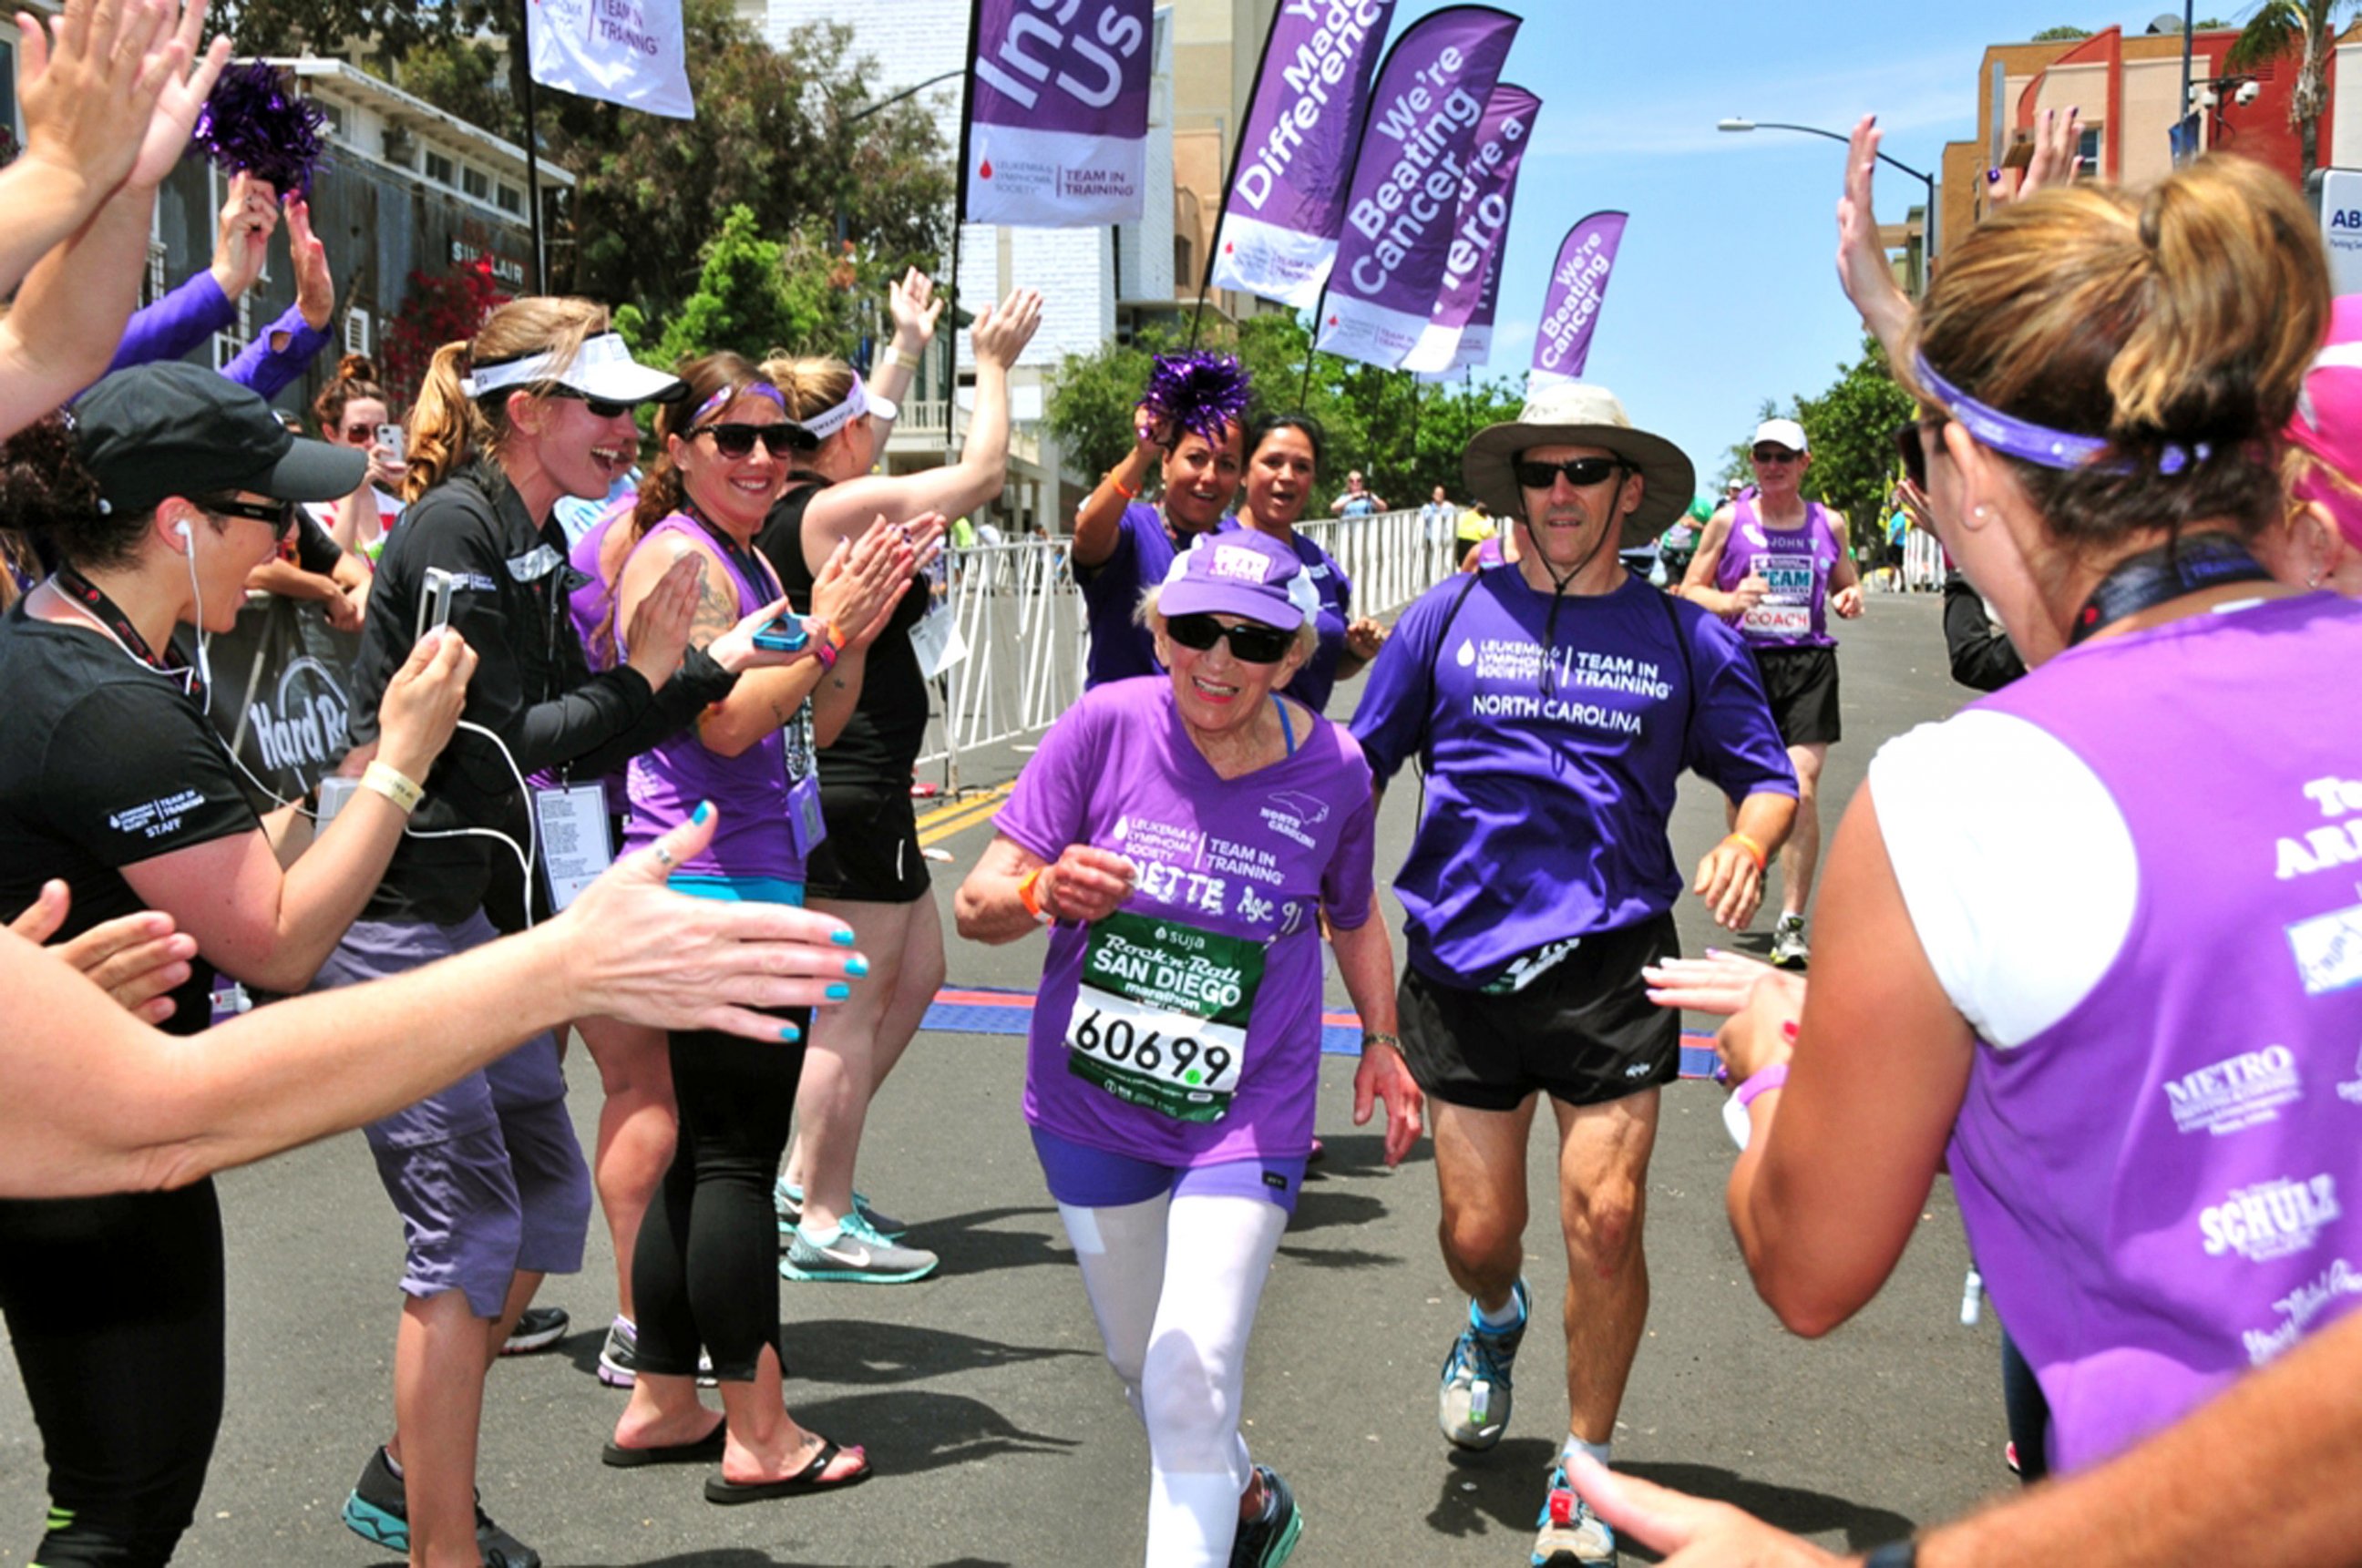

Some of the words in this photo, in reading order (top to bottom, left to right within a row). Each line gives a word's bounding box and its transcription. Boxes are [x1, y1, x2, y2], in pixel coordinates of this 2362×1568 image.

[1056, 5, 1143, 108] Us
[1236, 0, 1391, 210] Differenc
[1376, 46, 1463, 141] We're
[1501, 117, 1525, 140] a
[1065, 169, 1106, 183] TEAM
[1109, 171, 1125, 183] IN
[1349, 87, 1482, 241] Beating
[1065, 183, 1134, 197] TRAINING
[1350, 150, 1463, 294] Cancer
[1433, 193, 1507, 314] ero
[1556, 232, 1601, 286] We're
[1541, 253, 1609, 339] Beating
[1541, 286, 1601, 369] Cancer
[1771, 537, 1804, 548] JOHN
[1745, 611, 1808, 627] COACH
[1575, 669, 1669, 700] TRAINING
[1576, 651, 1633, 674] TEAM
[1638, 662, 1659, 679] IN
[249, 696, 326, 771] Hard
[1473, 694, 1539, 717] NORTH
[1542, 699, 1641, 735] CAROLINA
[145, 817, 181, 838] STAFF
[1127, 830, 1193, 854] LYMPHOMA
[1131, 817, 1186, 839] LEUKEMIA
[1125, 842, 1175, 862] SOCIETY
[1207, 854, 1284, 886] TRAINING
[1210, 837, 1256, 863] TEAM
[1258, 851, 1276, 868] IN
[1237, 886, 1275, 924] Age
[1280, 900, 1303, 935] 91
[1105, 933, 1167, 966] Rock
[1188, 954, 1242, 984] Roll
[1169, 932, 1206, 950] suja
[1093, 948, 1150, 983] SAN
[1155, 966, 1241, 1008] DIEGO
[1125, 982, 1200, 1011] marathon
[1076, 1009, 1231, 1086] 60699
[2163, 1044, 2294, 1103] METRO
[2198, 1173, 2341, 1255] SCHULZ
